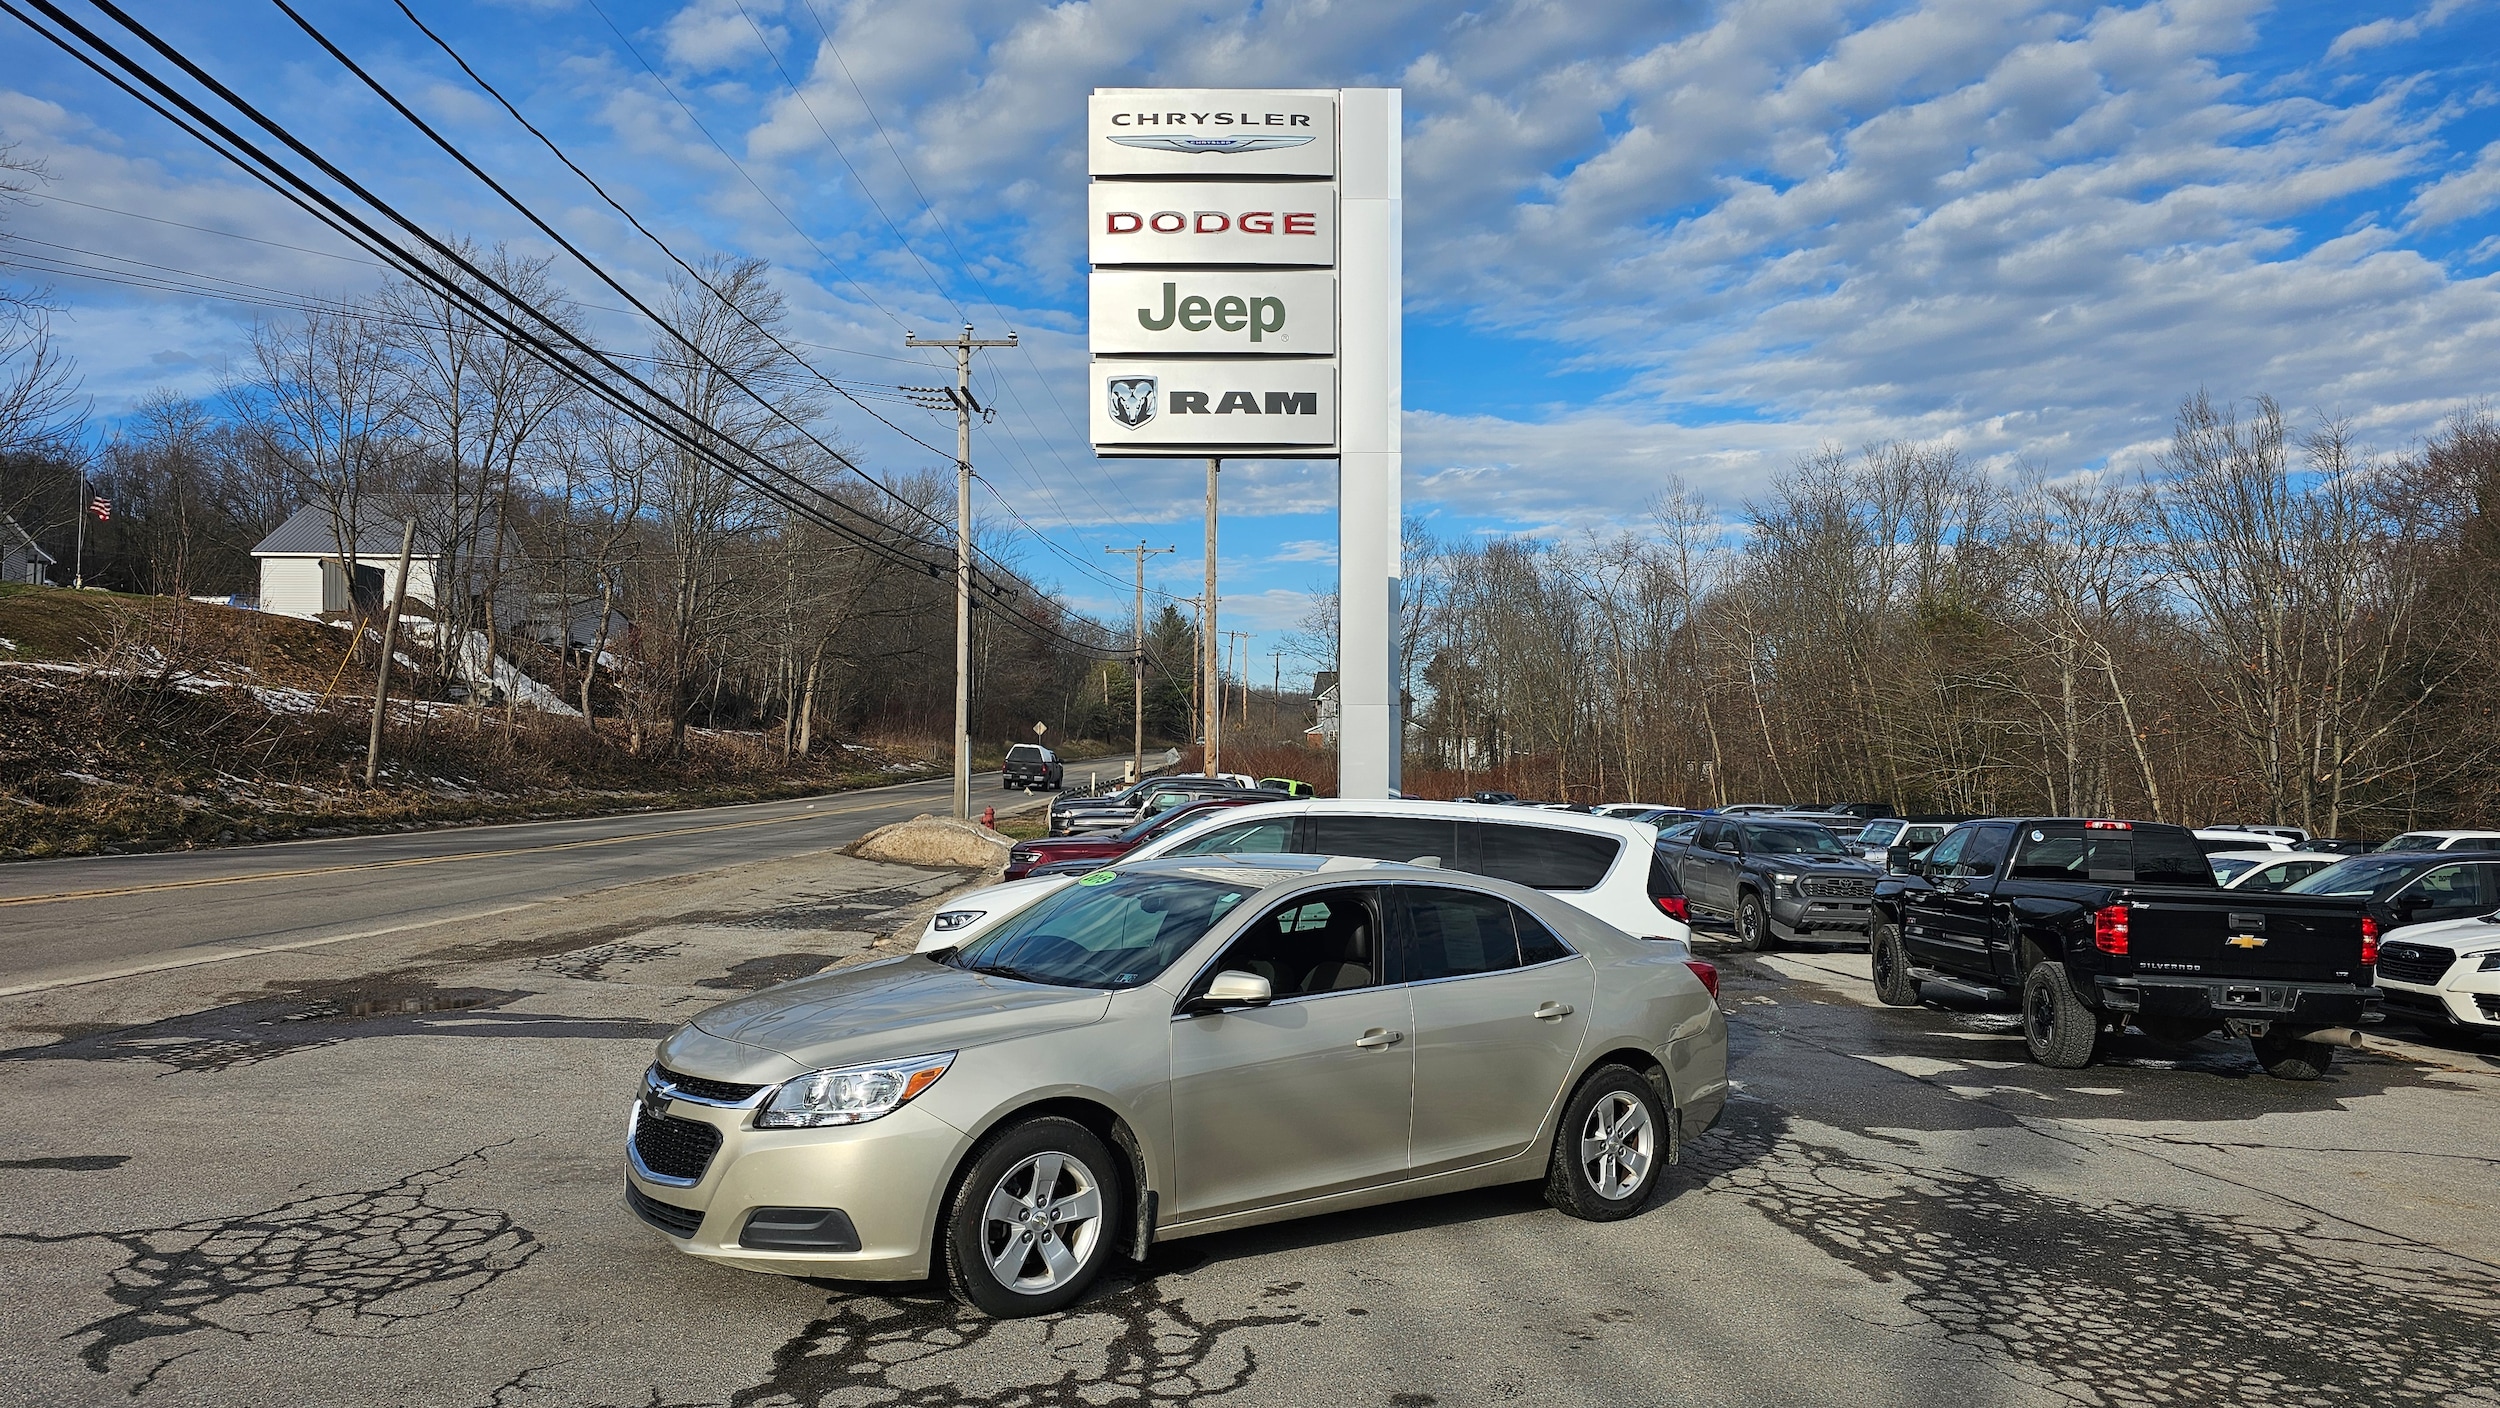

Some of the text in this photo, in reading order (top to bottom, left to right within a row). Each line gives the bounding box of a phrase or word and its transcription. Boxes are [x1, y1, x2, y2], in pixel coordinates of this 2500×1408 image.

[1111, 112, 1311, 127] CHRYSLER
[1106, 211, 1317, 235] DODGE
[1138, 282, 1286, 343] Jeep
[1169, 391, 1317, 415] RAM
[2139, 962, 2201, 971] SILVERADO
